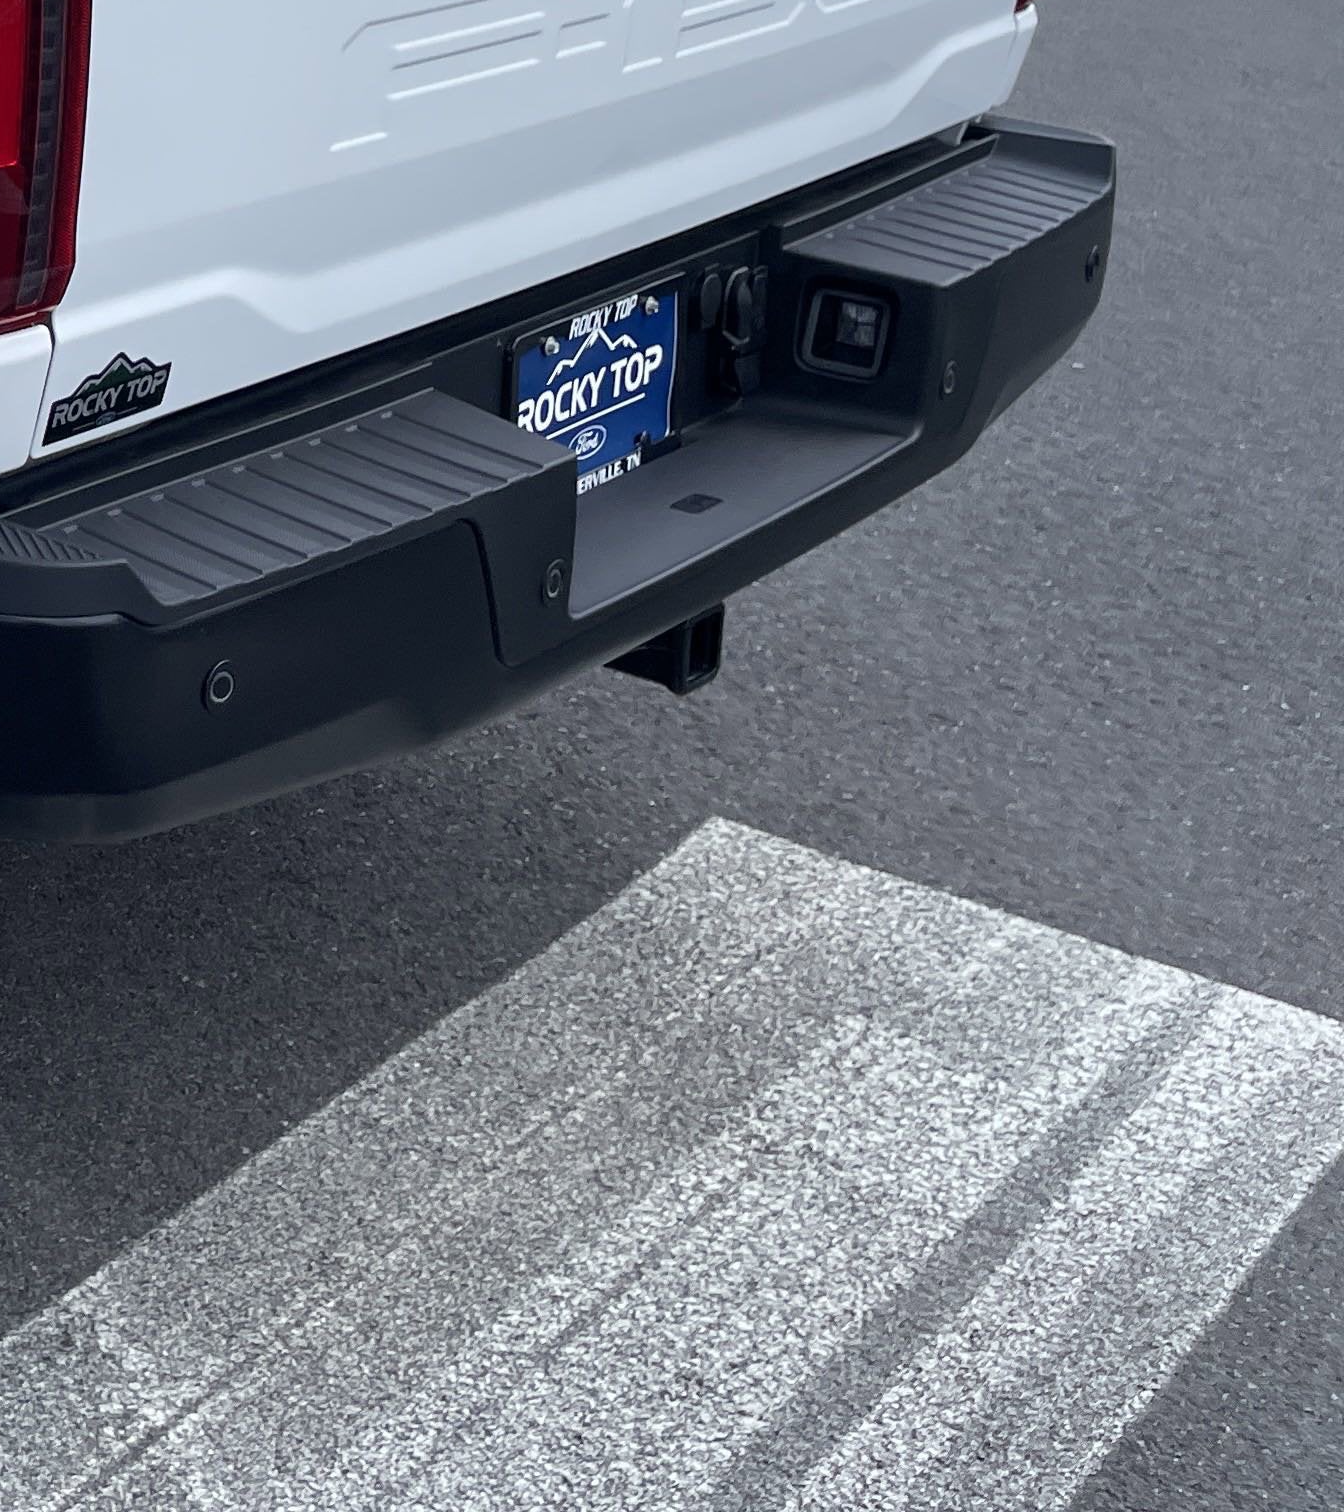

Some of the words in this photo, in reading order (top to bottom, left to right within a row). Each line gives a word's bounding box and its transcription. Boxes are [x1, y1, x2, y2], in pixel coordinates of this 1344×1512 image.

[569, 306, 612, 340] ROCKY
[614, 294, 638, 322] TOP
[52, 384, 124, 428] ROCKY
[127, 369, 168, 402] TOP
[518, 367, 606, 432] ROCKY
[611, 344, 663, 397] TOP
[575, 431, 600, 456] Ford
[577, 461, 624, 495] ERVILLE,
[626, 447, 642, 472] TN
